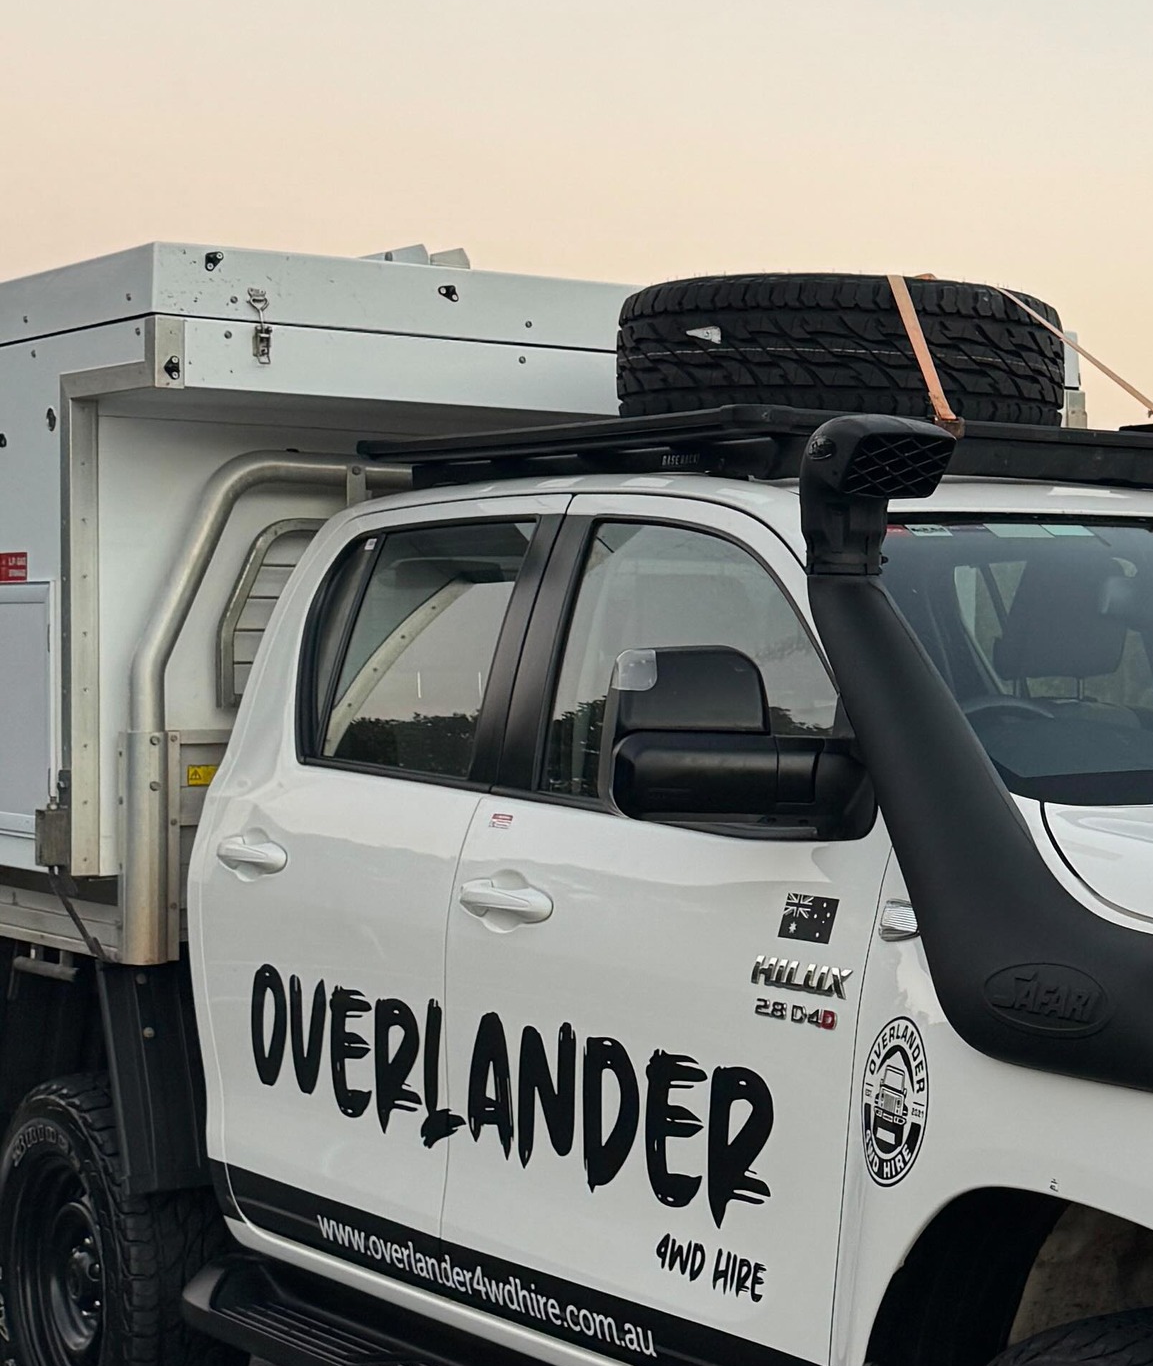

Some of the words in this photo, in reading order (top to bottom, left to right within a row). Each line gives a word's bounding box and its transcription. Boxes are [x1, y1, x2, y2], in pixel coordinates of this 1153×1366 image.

[750, 955, 854, 1001] HILUX
[991, 971, 1100, 1025] SAFARI
[868, 1023, 926, 1095] OVERLANDER
[250, 963, 774, 1230] OVERLANDER
[883, 1143, 912, 1178] HIRE
[316, 1213, 658, 1358] www.overlander4wdhire.com.au
[655, 1232, 706, 1285] 4WD
[712, 1252, 768, 1304] HIRE
